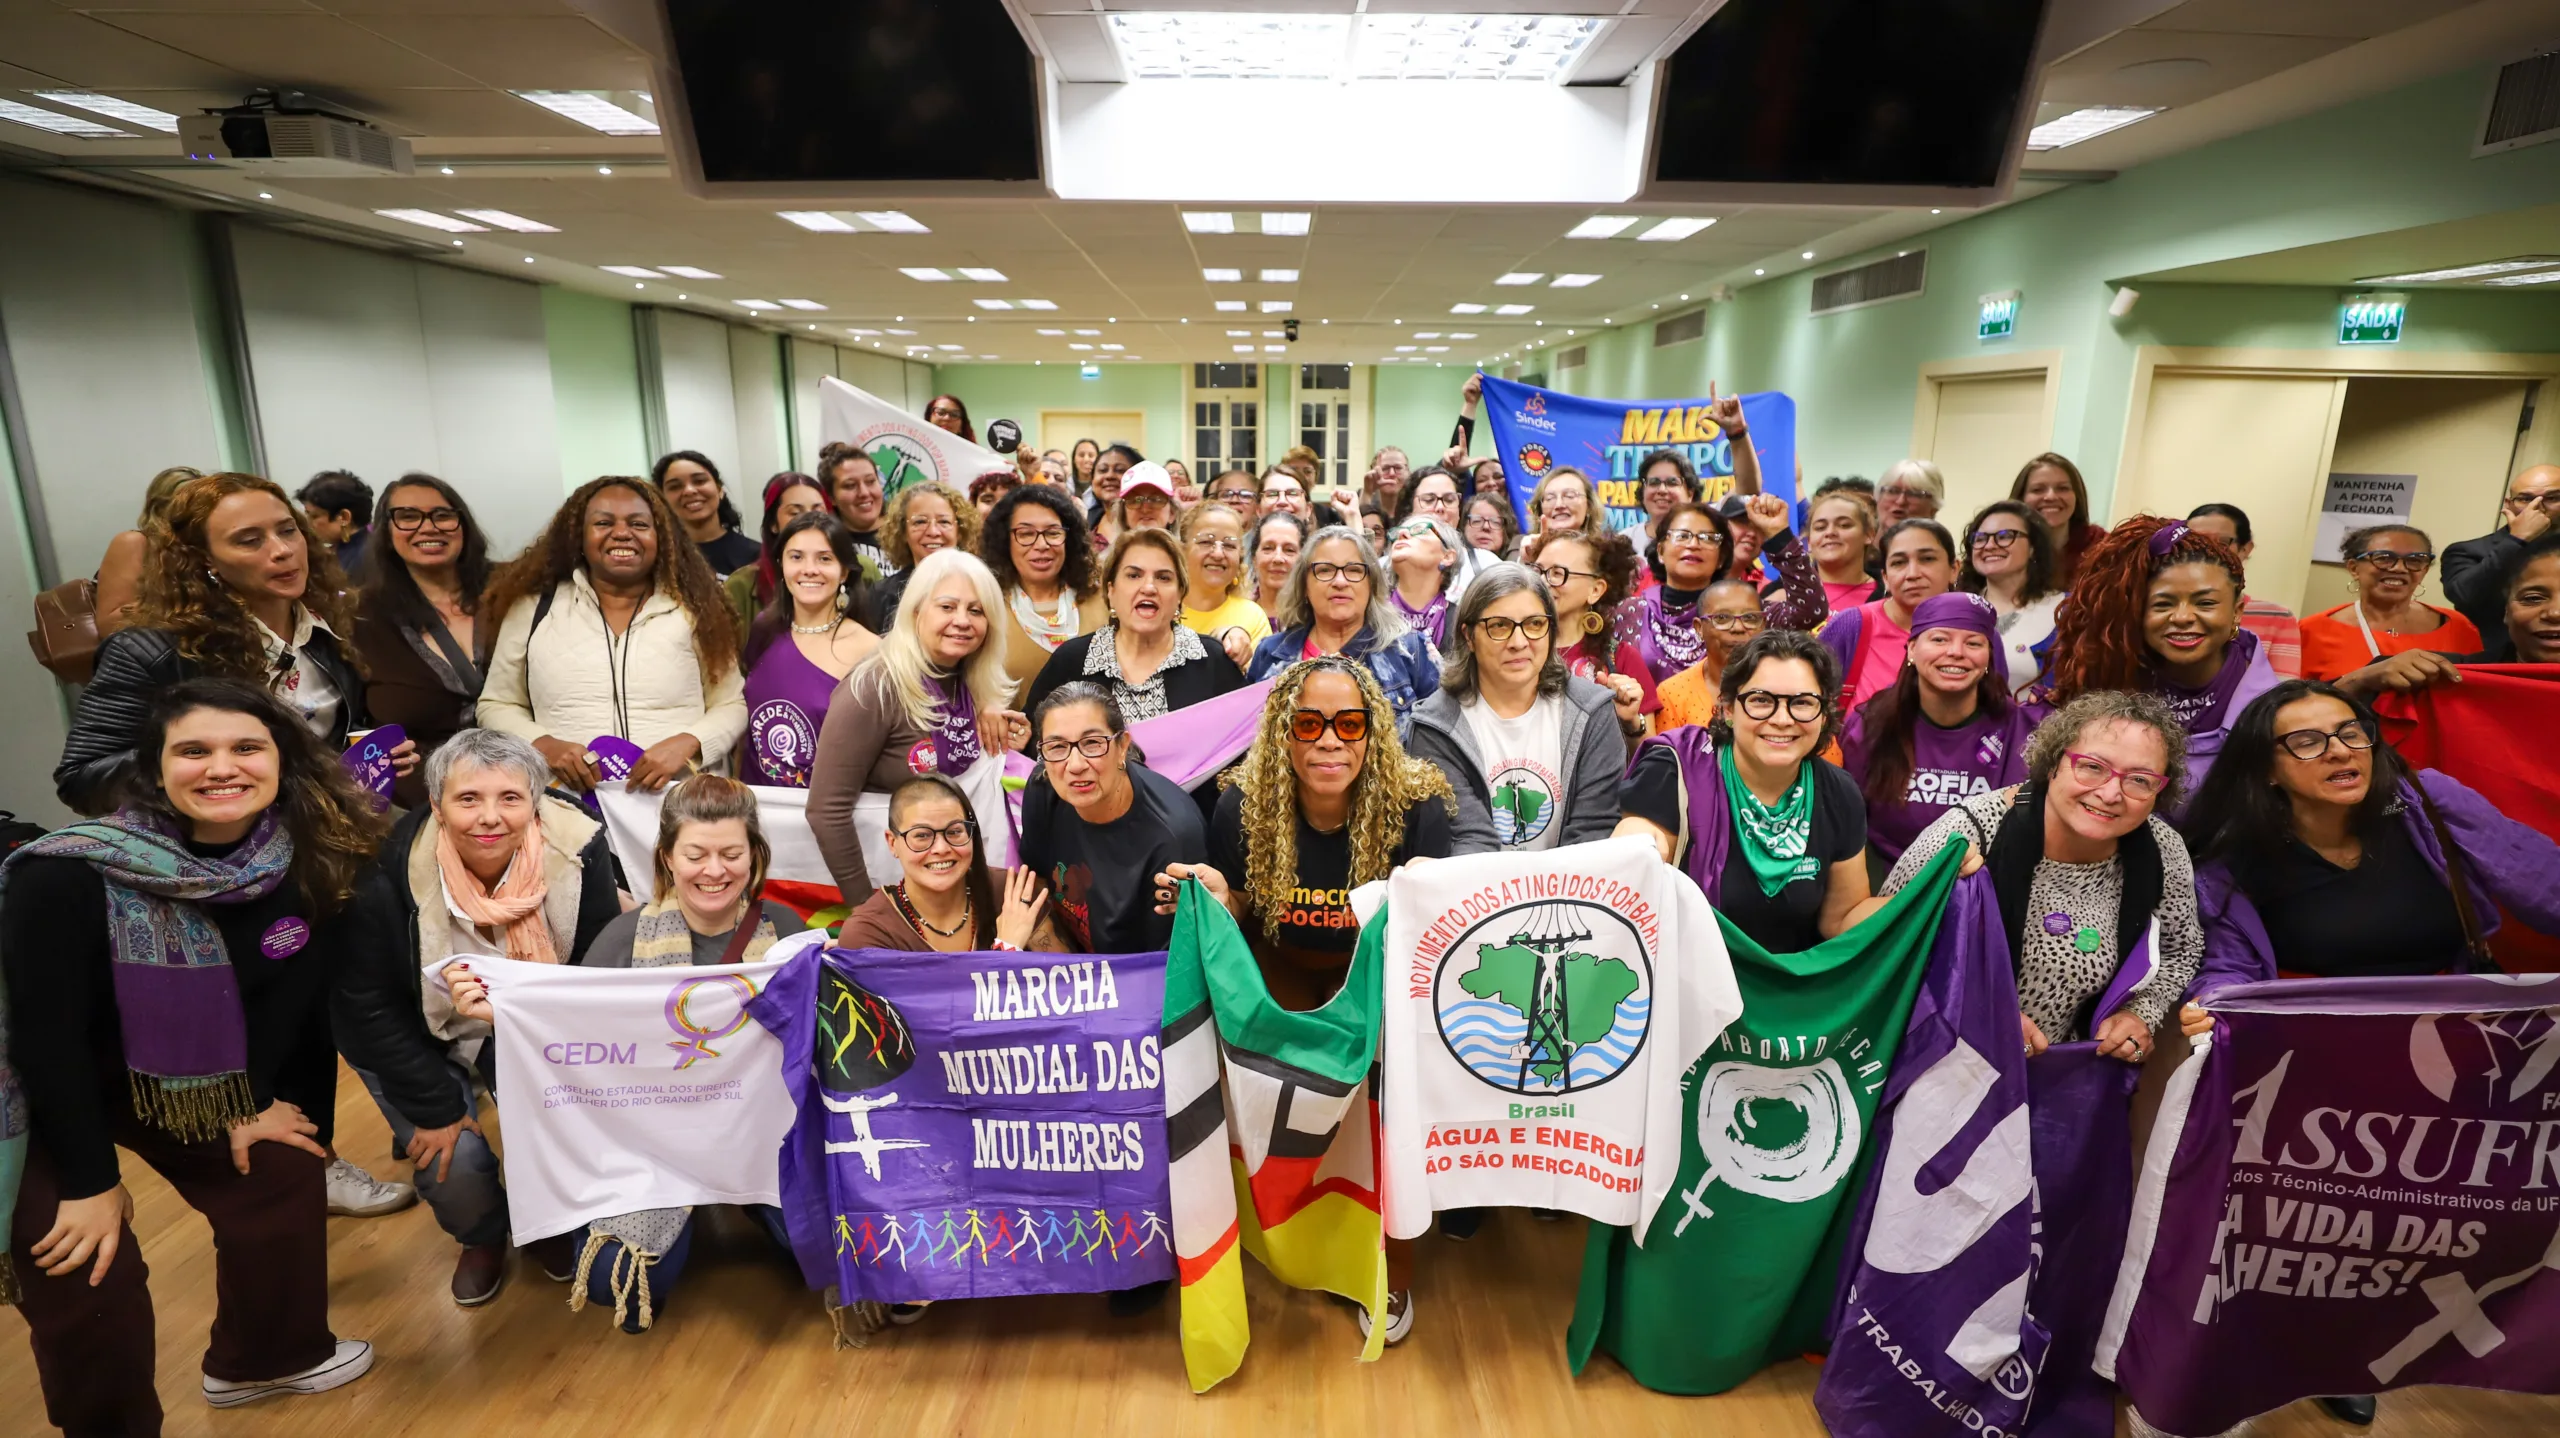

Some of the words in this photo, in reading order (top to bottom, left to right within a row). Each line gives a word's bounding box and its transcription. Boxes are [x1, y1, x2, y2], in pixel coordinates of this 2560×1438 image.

[1515, 411, 1556, 431] Sindec
[1620, 405, 1720, 444] MAIS
[1604, 438, 1735, 479] TEPO
[2333, 480, 2405, 491] MANTENHA
[2338, 492, 2347, 501] A
[2351, 493, 2394, 502] PORTA
[2333, 504, 2394, 515] FECHADA
[753, 705, 783, 730] REDE
[789, 715, 807, 753] FEMINISTA
[601, 757, 621, 776] PARA
[611, 754, 628, 770] NÃO
[1409, 907, 1468, 1000] MOVIMENTO
[1461, 886, 1501, 919] DOS
[1501, 873, 1606, 907] ATINGIDOS
[1600, 880, 1634, 912] POR
[970, 961, 1119, 1022] MARCHA
[543, 1042, 637, 1066] CEDM
[1720, 1030, 1828, 1061] ABORTO
[938, 1043, 1088, 1095] MUNDIAL
[1092, 1035, 1161, 1092] DAS
[544, 1084, 604, 1097] CONSELHO
[606, 1084, 664, 1096] ESTADUAL
[669, 1084, 692, 1094] DOS
[695, 1079, 742, 1094] DIREITOS
[544, 1099, 560, 1109] DA
[561, 1095, 608, 1109] MULHER
[610, 1099, 630, 1108] DO
[632, 1097, 651, 1107] RIO
[656, 1094, 702, 1105] GRANDE
[704, 1092, 722, 1101] DO
[724, 1091, 744, 1100] SUL
[1508, 1102, 1575, 1119] Brasil
[972, 1118, 1144, 1173] MULHERES
[1425, 1125, 1501, 1150] ÁGUA
[1510, 1127, 1526, 1144] E
[1425, 1154, 1453, 1176] ÃO
[1459, 1150, 1504, 1169] SÃO
[2233, 1168, 2264, 1185] dos
[2271, 1171, 2505, 1211] Técnico-Administrativos
[2511, 1196, 2532, 1212] da
[2224, 1194, 2244, 1239] A
[2265, 1195, 2374, 1251] VIDA
[2386, 1213, 2487, 1259] DAS
[1856, 1307, 2018, 1438] TRABALHADO
